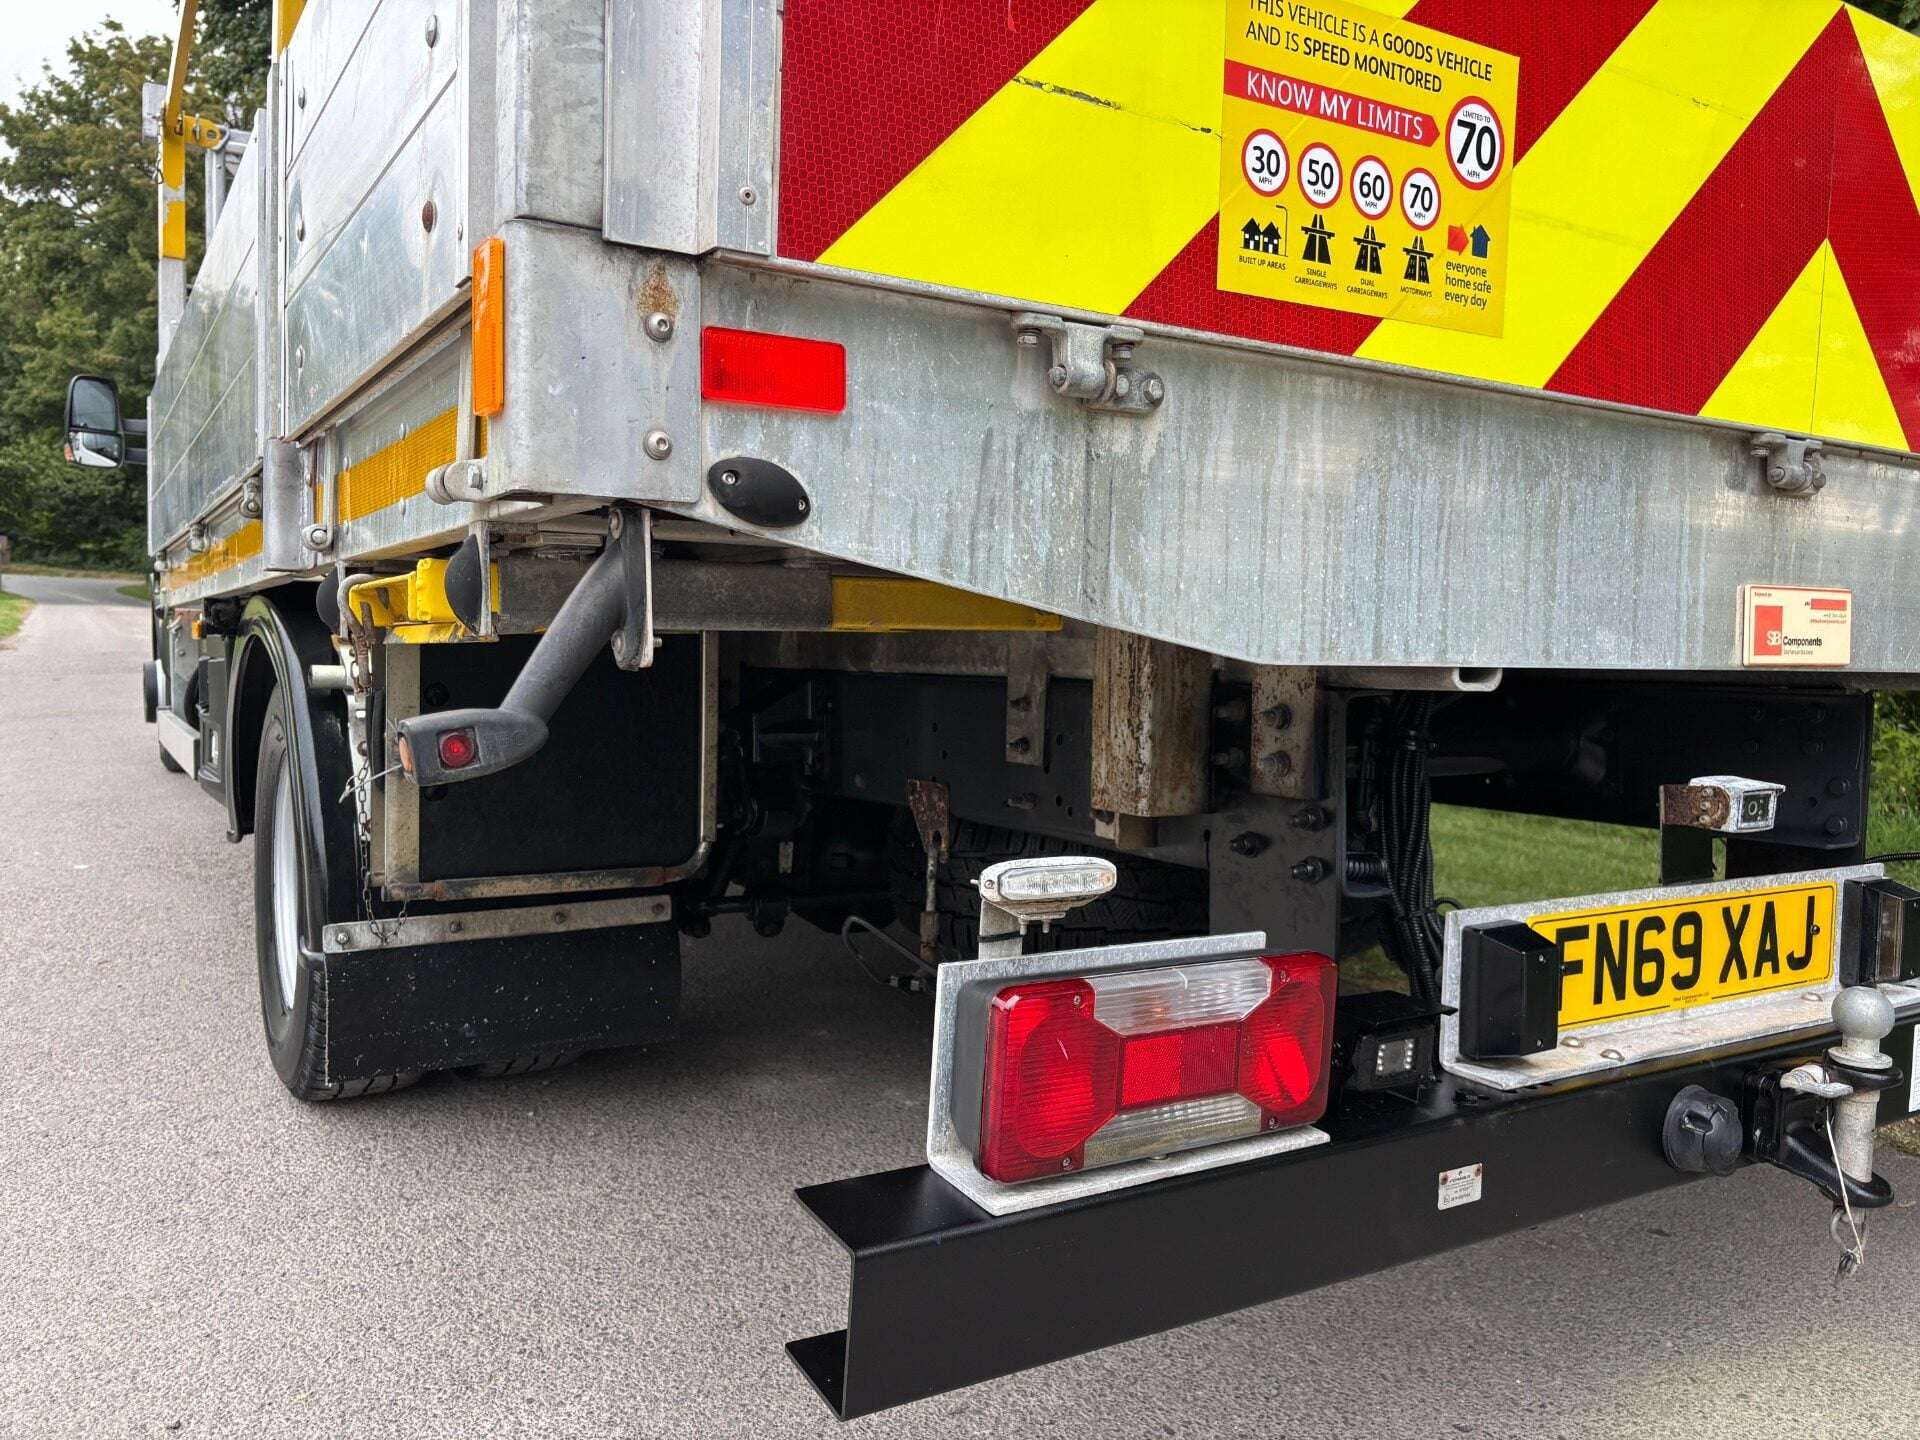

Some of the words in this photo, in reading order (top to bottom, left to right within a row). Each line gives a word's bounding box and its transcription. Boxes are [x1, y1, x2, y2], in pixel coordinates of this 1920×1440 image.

[1288, 2, 1349, 38] VEHICLE
[1352, 22, 1366, 43] IS
[1369, 29, 1379, 47] A
[1383, 32, 1433, 63] GOODS
[1437, 48, 1493, 81] VEHICLE
[1246, 21, 1281, 46] AND
[1285, 31, 1299, 52] IS
[1303, 37, 1350, 66] SPEED
[1354, 52, 1442, 93] MONITORED
[1247, 71, 1314, 111] KNOW
[1319, 90, 1352, 121] MY
[1357, 101, 1423, 140] LIMITS
[1462, 109, 1483, 122] LIMITED
[1483, 115, 1491, 123] TO
[1456, 118, 1496, 172] 70
[1251, 145, 1280, 177] 30
[1258, 175, 1272, 185] MPH
[1307, 158, 1334, 189] 50
[1466, 169, 1480, 180] MPH
[1313, 188, 1326, 198] MPH
[1359, 171, 1385, 201] 60
[1364, 200, 1377, 209] MPH
[1410, 182, 1433, 212] 70
[1413, 211, 1426, 221] MPH
[1238, 255, 1257, 265] BUILT
[1257, 258, 1266, 266] UP
[1266, 260, 1286, 271] AREAS
[1446, 260, 1487, 278] everyone
[1306, 267, 1327, 279] SINGLE
[1294, 276, 1338, 290] CARRIAGEWAYS
[1360, 278, 1375, 288] DUAL
[1445, 273, 1471, 290] home
[1472, 280, 1492, 293] safe
[1346, 285, 1388, 299] CARRIAGEWAYS
[1400, 286, 1433, 298] MOTORWAYS
[1444, 290, 1469, 307] every
[1470, 294, 1487, 310] day
[1783, 635, 1823, 648] Components
[1556, 911, 1703, 1011] FN69
[1719, 895, 1816, 984] XAJ
